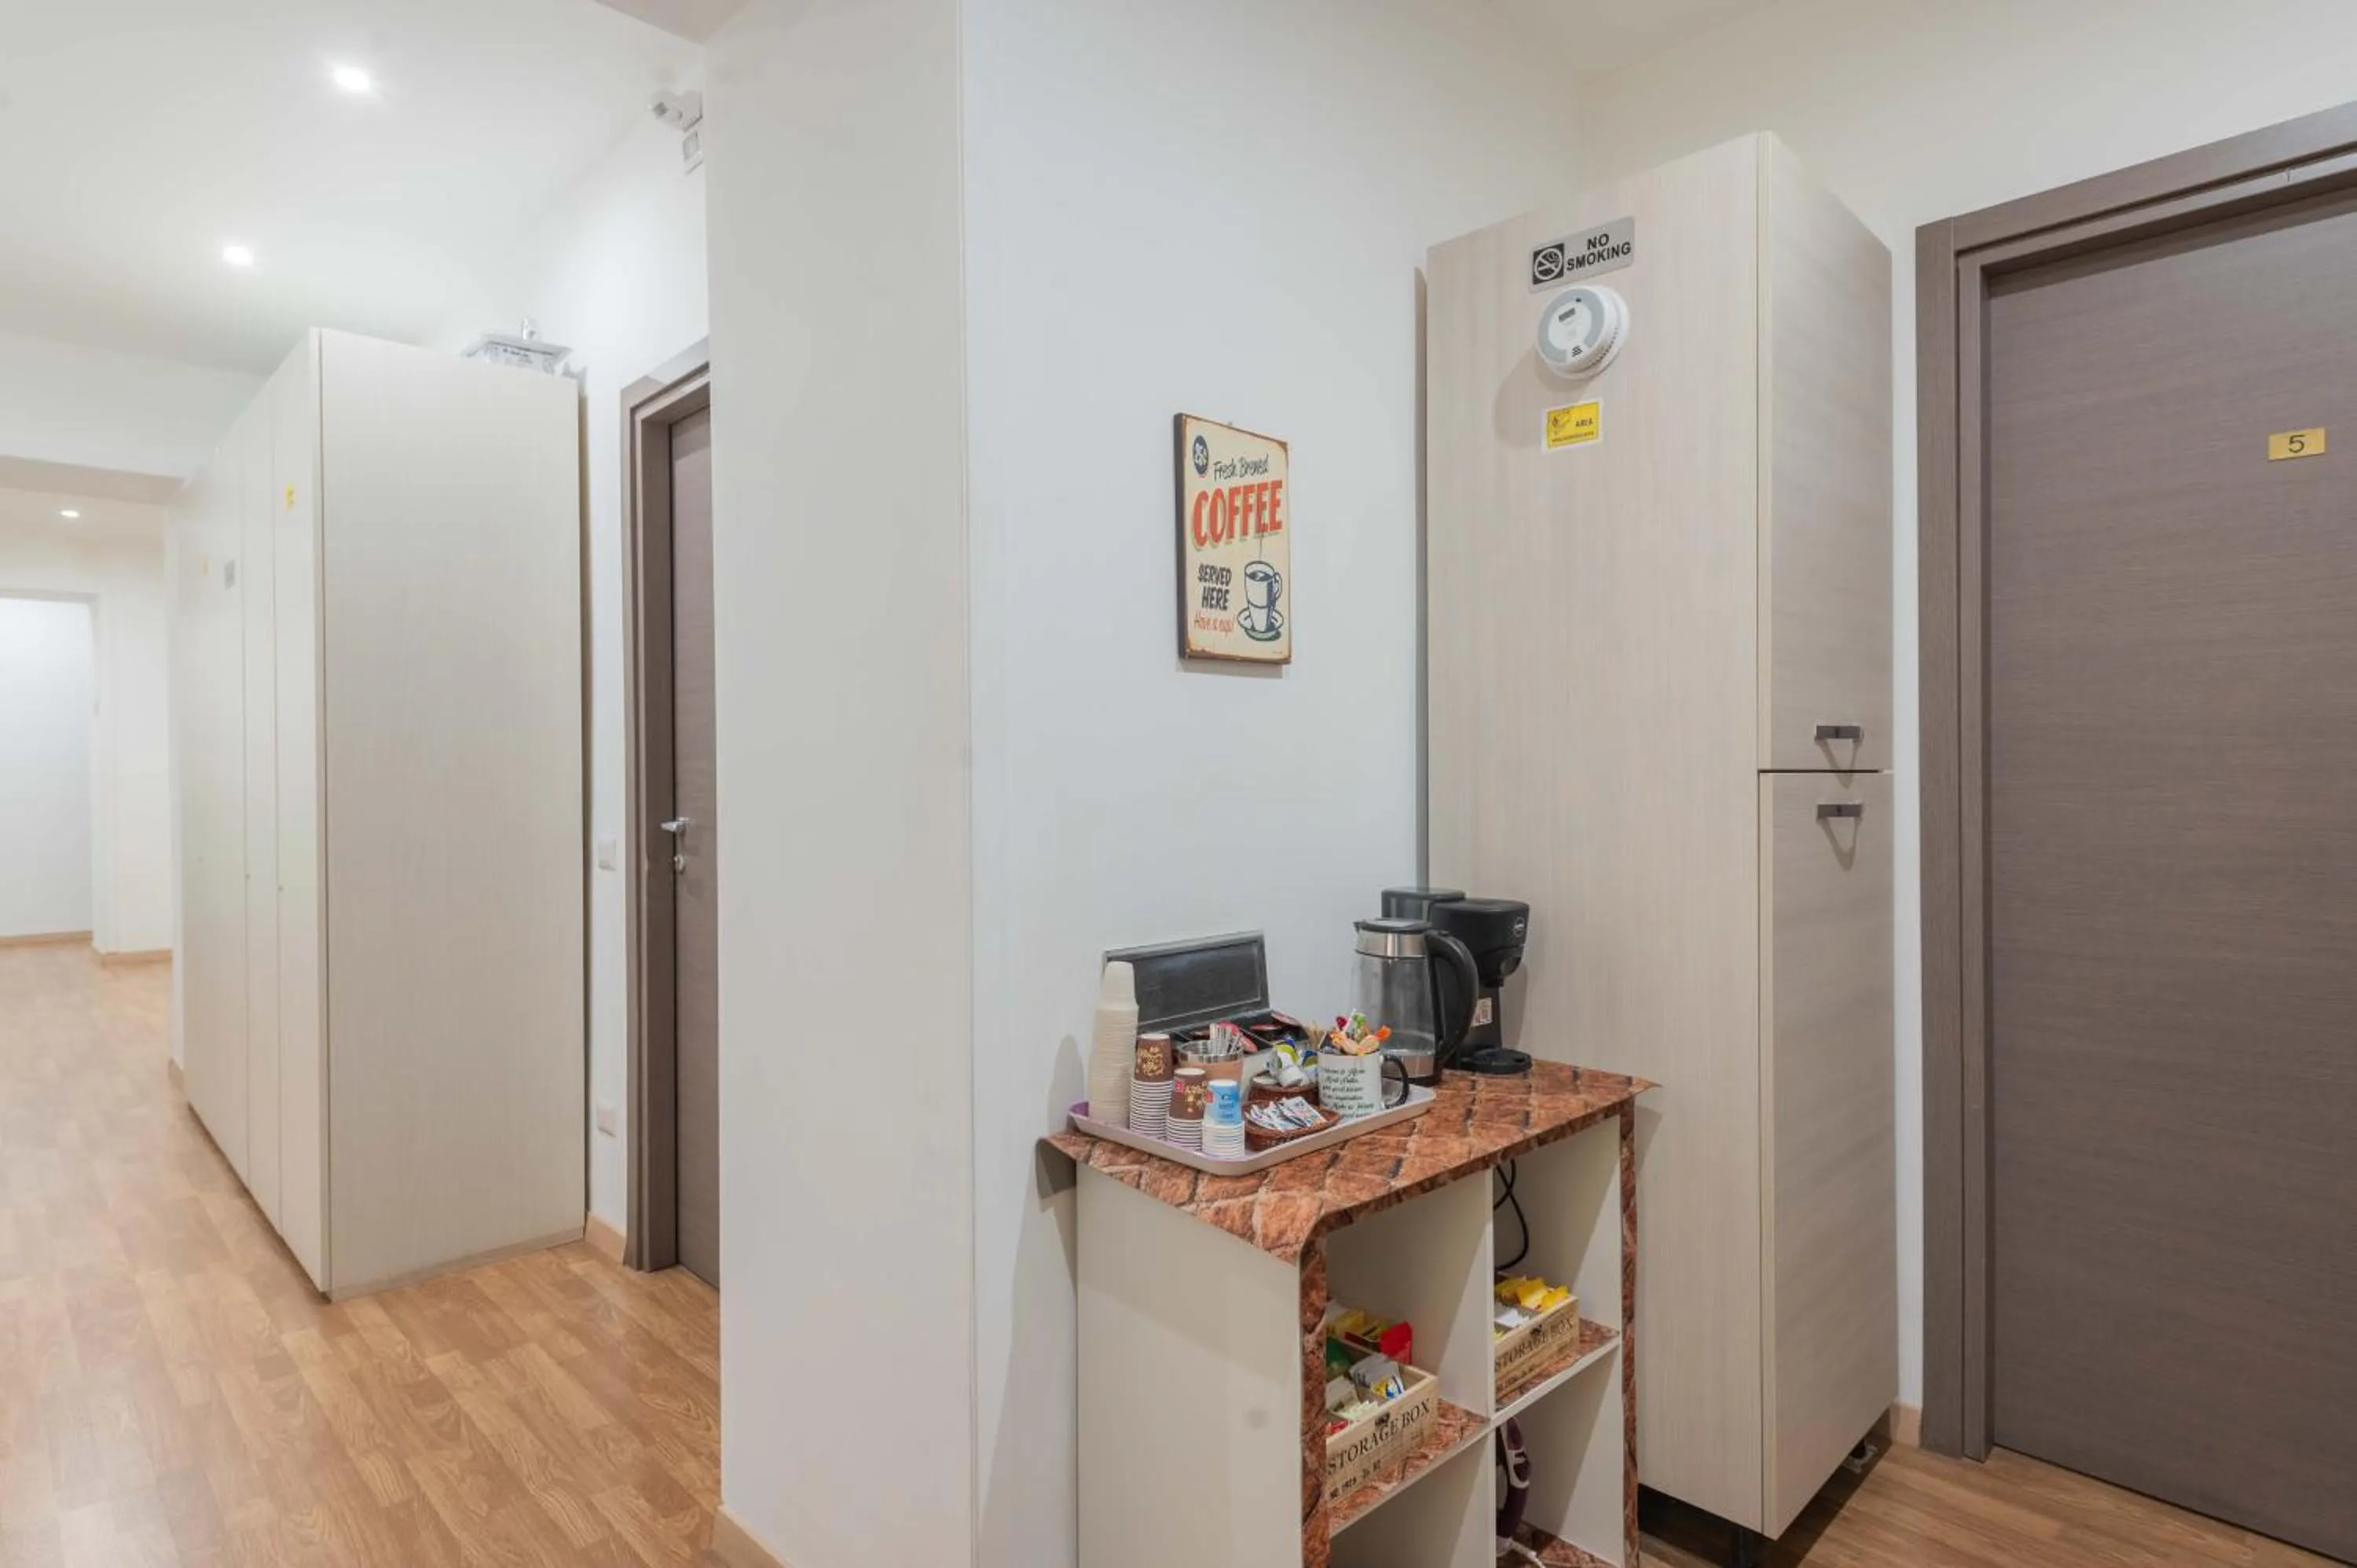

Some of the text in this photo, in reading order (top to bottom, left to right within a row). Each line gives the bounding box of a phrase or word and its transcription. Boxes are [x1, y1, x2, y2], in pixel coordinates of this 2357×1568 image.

[1587, 233, 1609, 251] NO
[1566, 241, 1632, 271] SMOKING
[2288, 434, 2305, 453] 5
[1193, 480, 1283, 547] COFFEE
[1197, 563, 1232, 586] SERVED
[1201, 587, 1230, 610] HERE
[1328, 1397, 1432, 1476] STORAGE BOX
